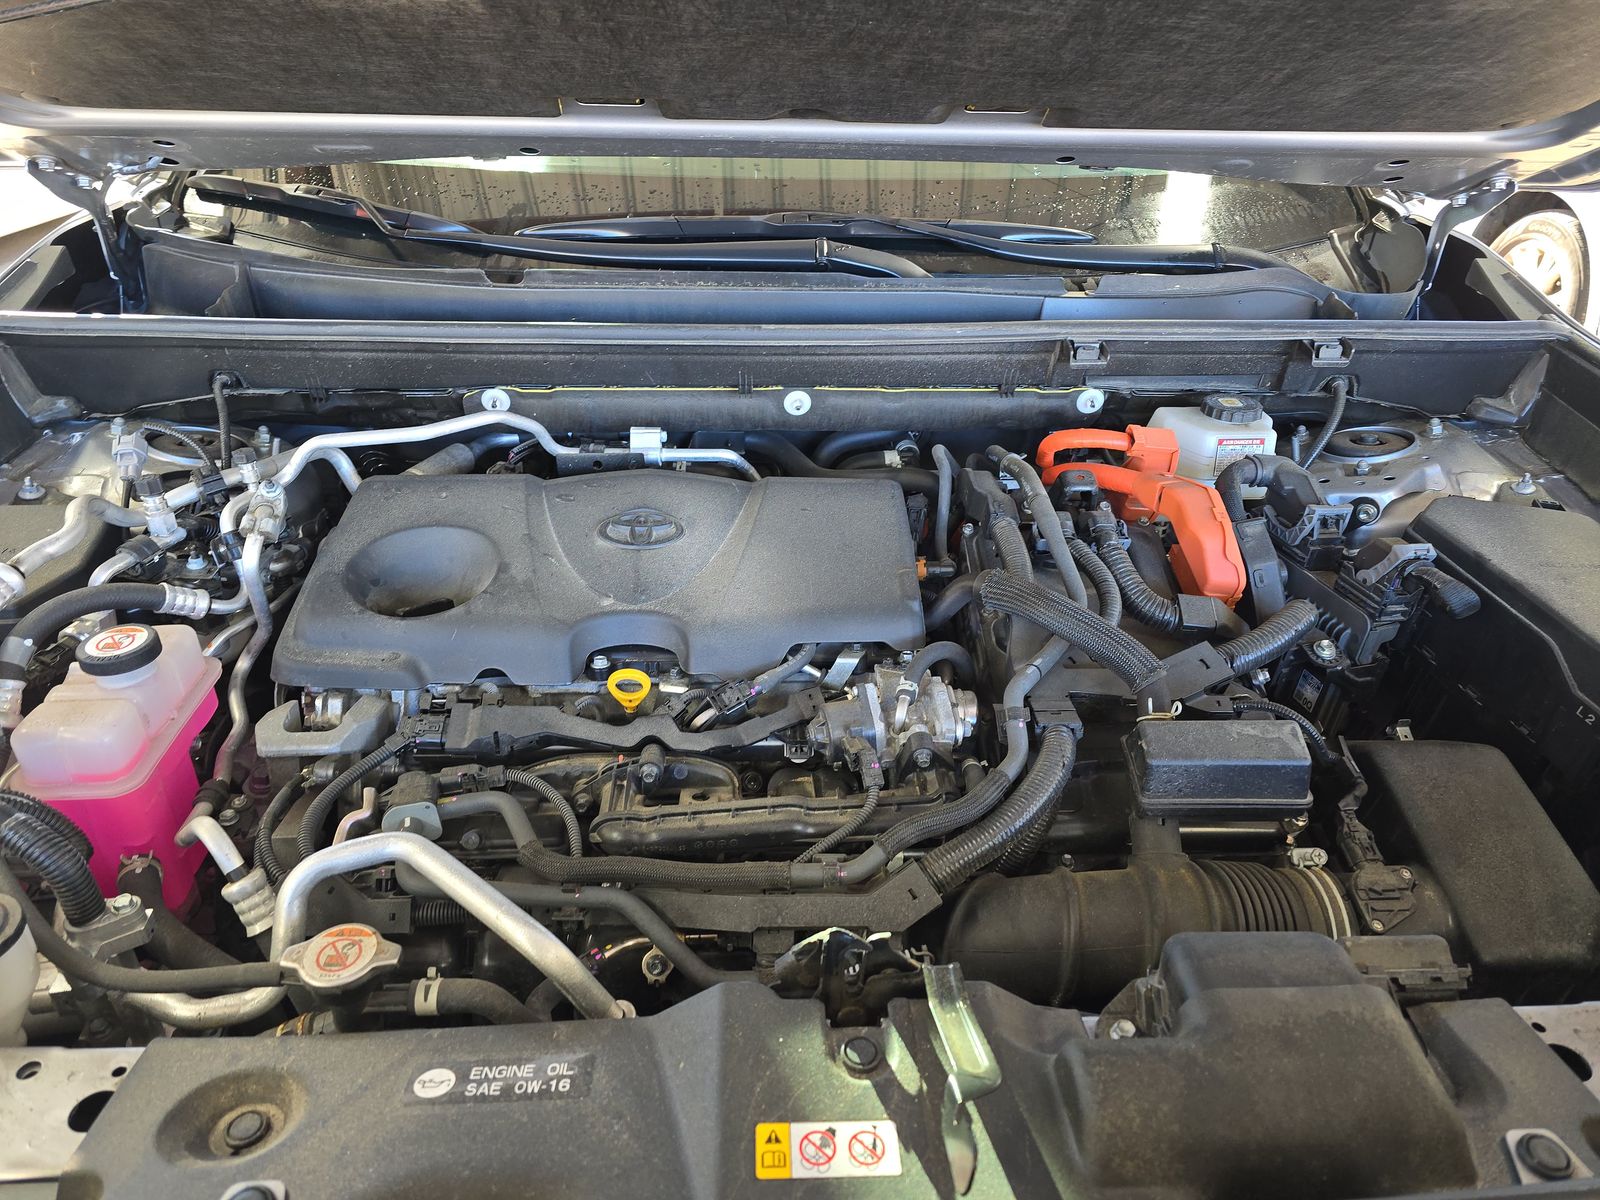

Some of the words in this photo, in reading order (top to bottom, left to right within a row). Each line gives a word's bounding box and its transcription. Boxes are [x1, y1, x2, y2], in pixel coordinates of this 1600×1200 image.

[469, 1064, 536, 1080] ENGINE
[546, 1063, 575, 1076] OIL
[464, 1082, 503, 1096] SAE
[513, 1079, 571, 1094] 0W-16
